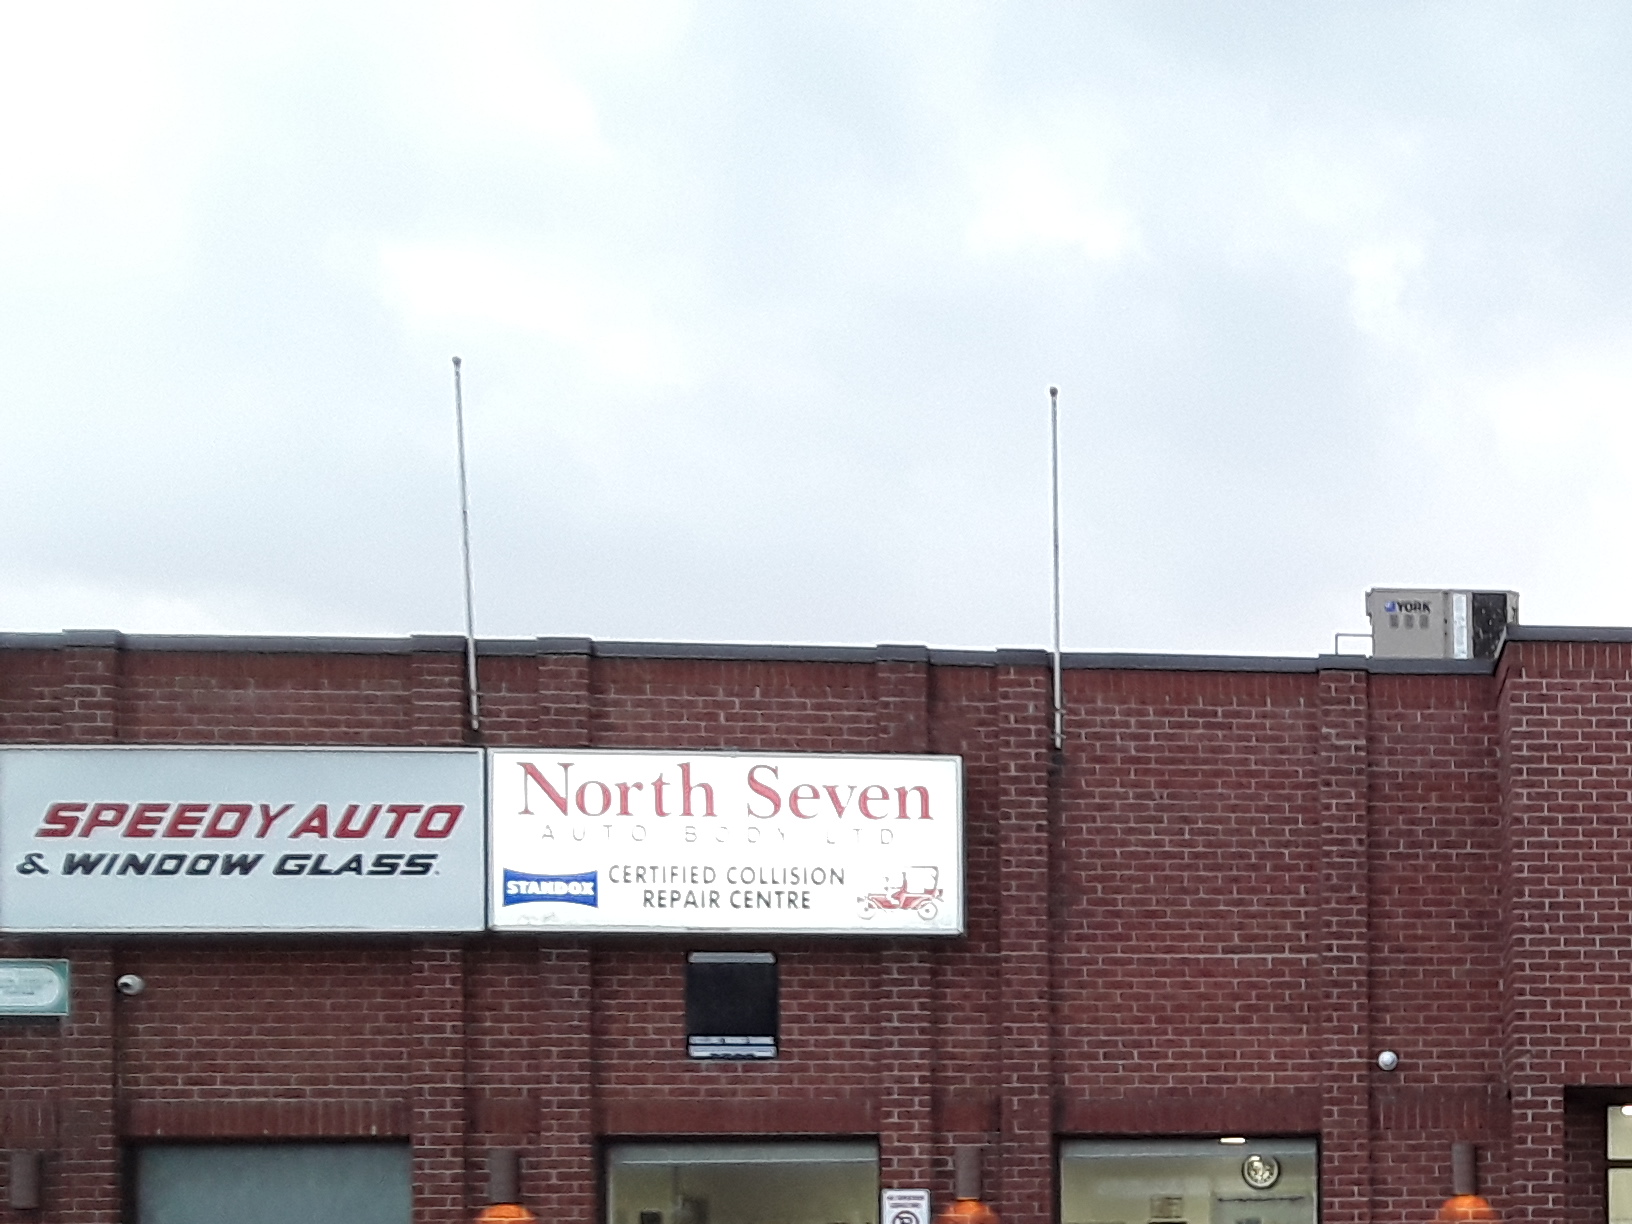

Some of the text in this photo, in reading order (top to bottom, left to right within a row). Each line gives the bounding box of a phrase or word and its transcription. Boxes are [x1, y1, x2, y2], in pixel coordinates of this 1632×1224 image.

[516, 761, 934, 820] North Seven
[35, 803, 464, 839] SPEEDY AUTO
[16, 853, 49, 875] &
[61, 853, 263, 876] WINDOW
[609, 865, 845, 886] CERTIFIED COLLISION
[507, 880, 594, 896] STANDOX
[643, 889, 811, 909] REPAIR CENTRE
